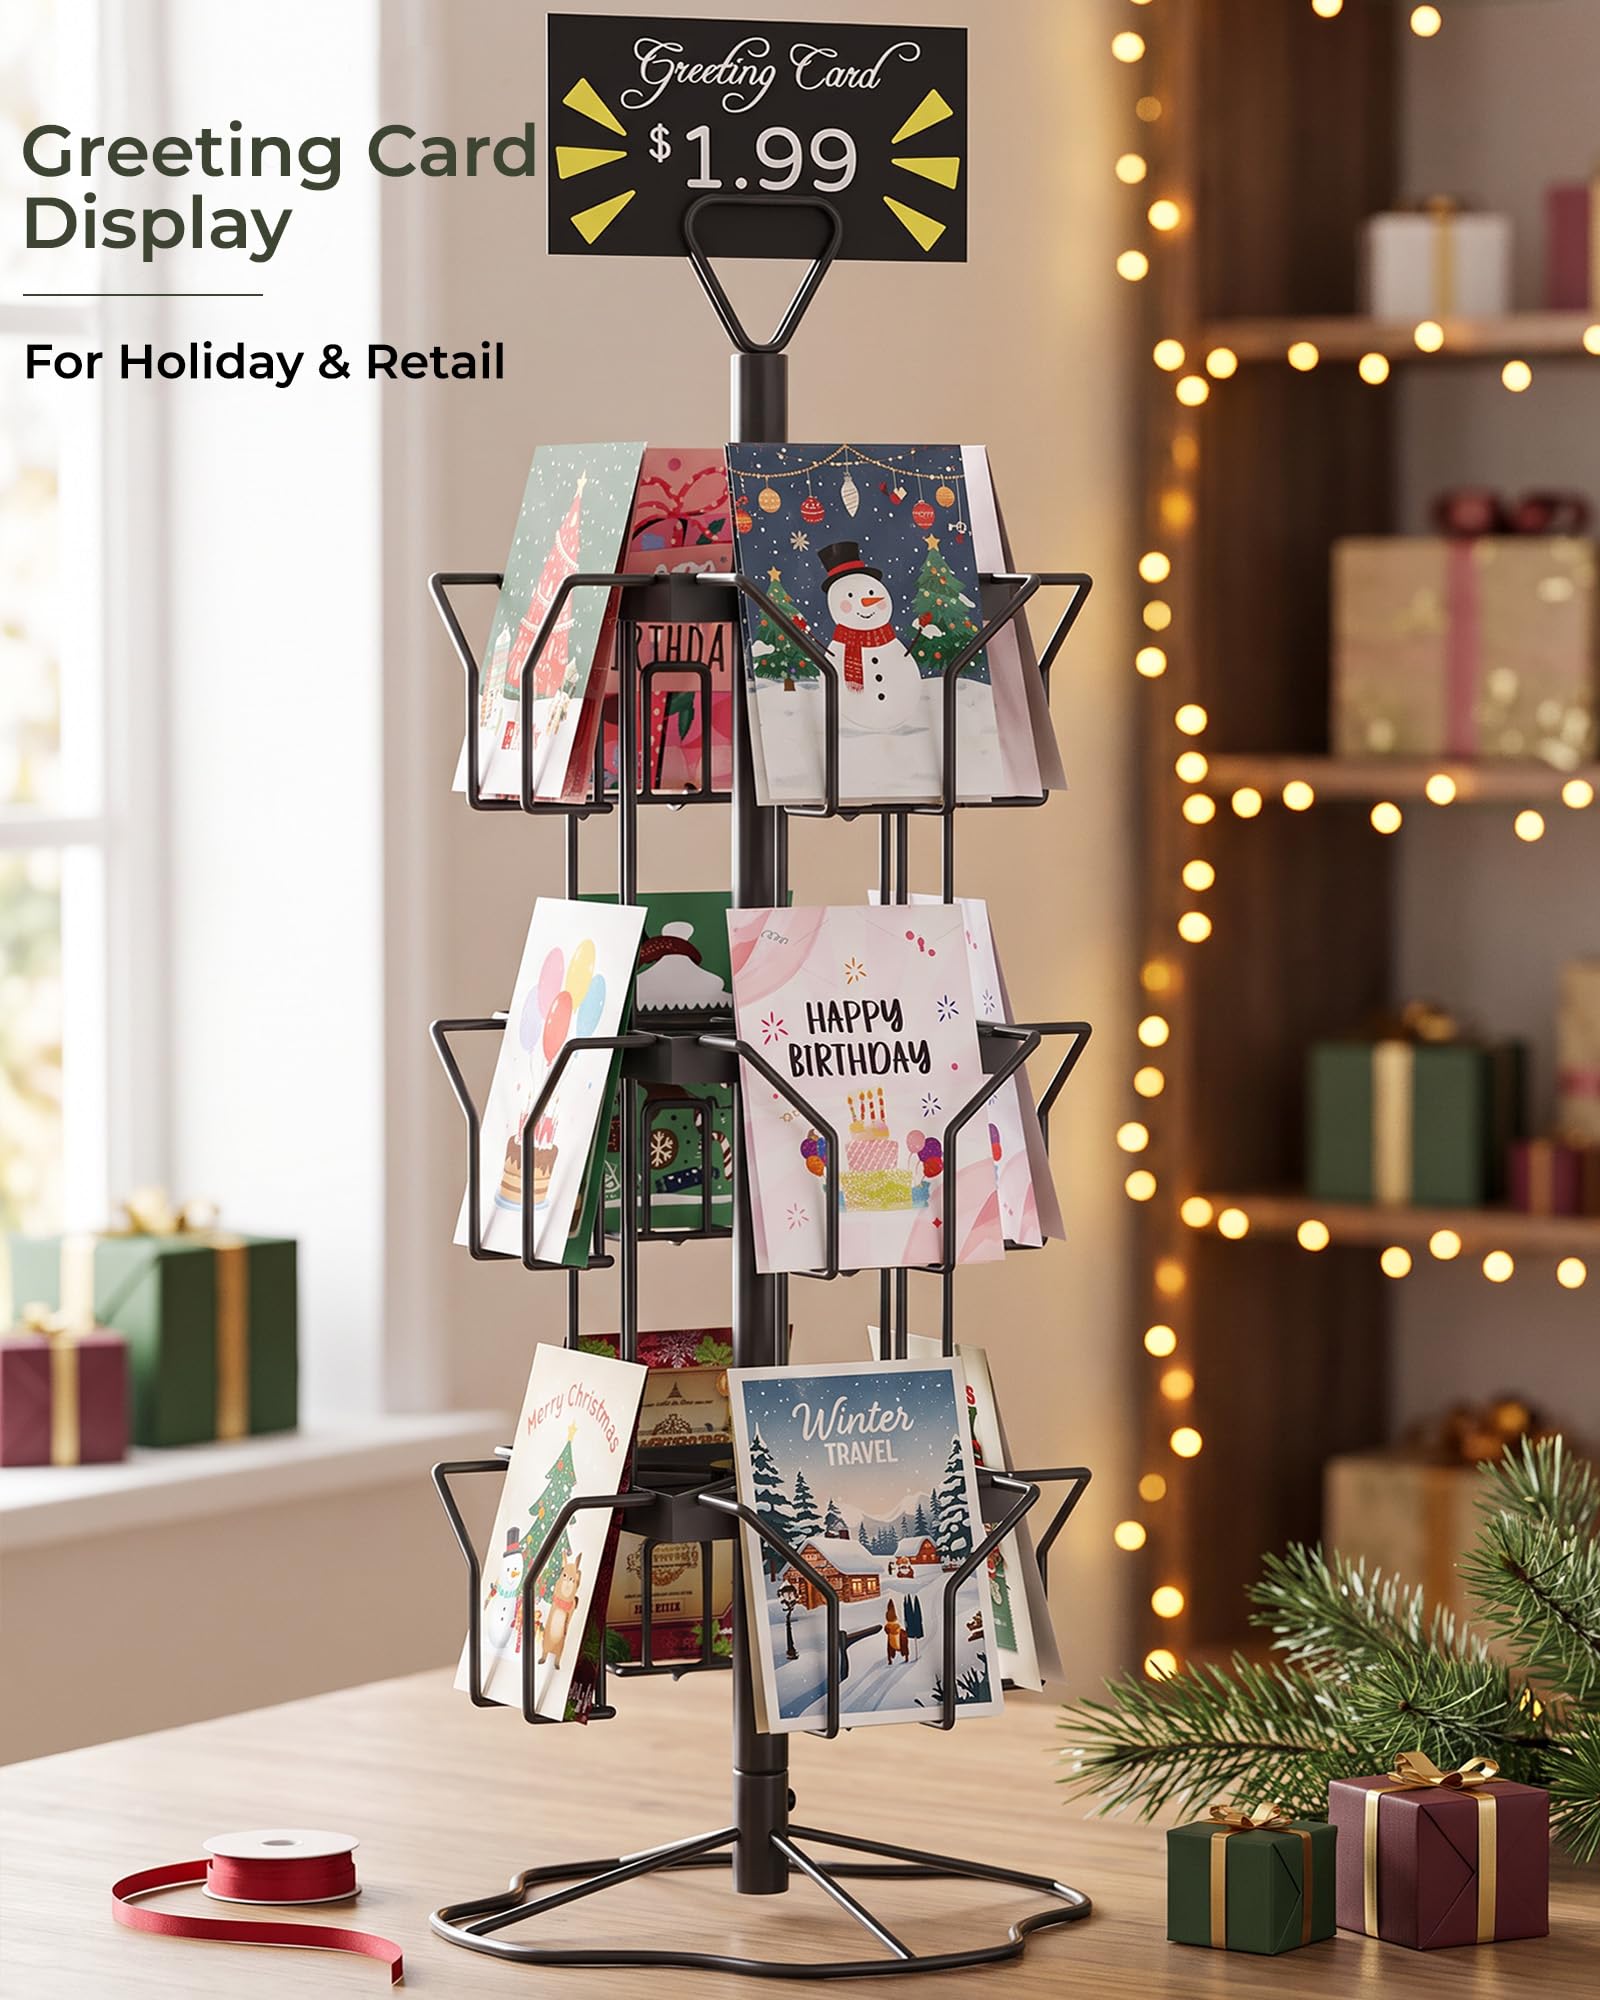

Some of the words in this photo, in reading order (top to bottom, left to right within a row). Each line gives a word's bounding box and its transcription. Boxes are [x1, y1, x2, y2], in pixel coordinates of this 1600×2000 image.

[620, 36, 777, 114] Greeting
[789, 41, 921, 91] Card
[806, 998, 903, 1035] HAPPY
[788, 1039, 931, 1078] BIRTHDAY
[527, 1393, 564, 1435] Merry
[568, 1381, 619, 1453] Christmas
[791, 1395, 915, 1441] Winter
[823, 1439, 898, 1466] TRAVEL
